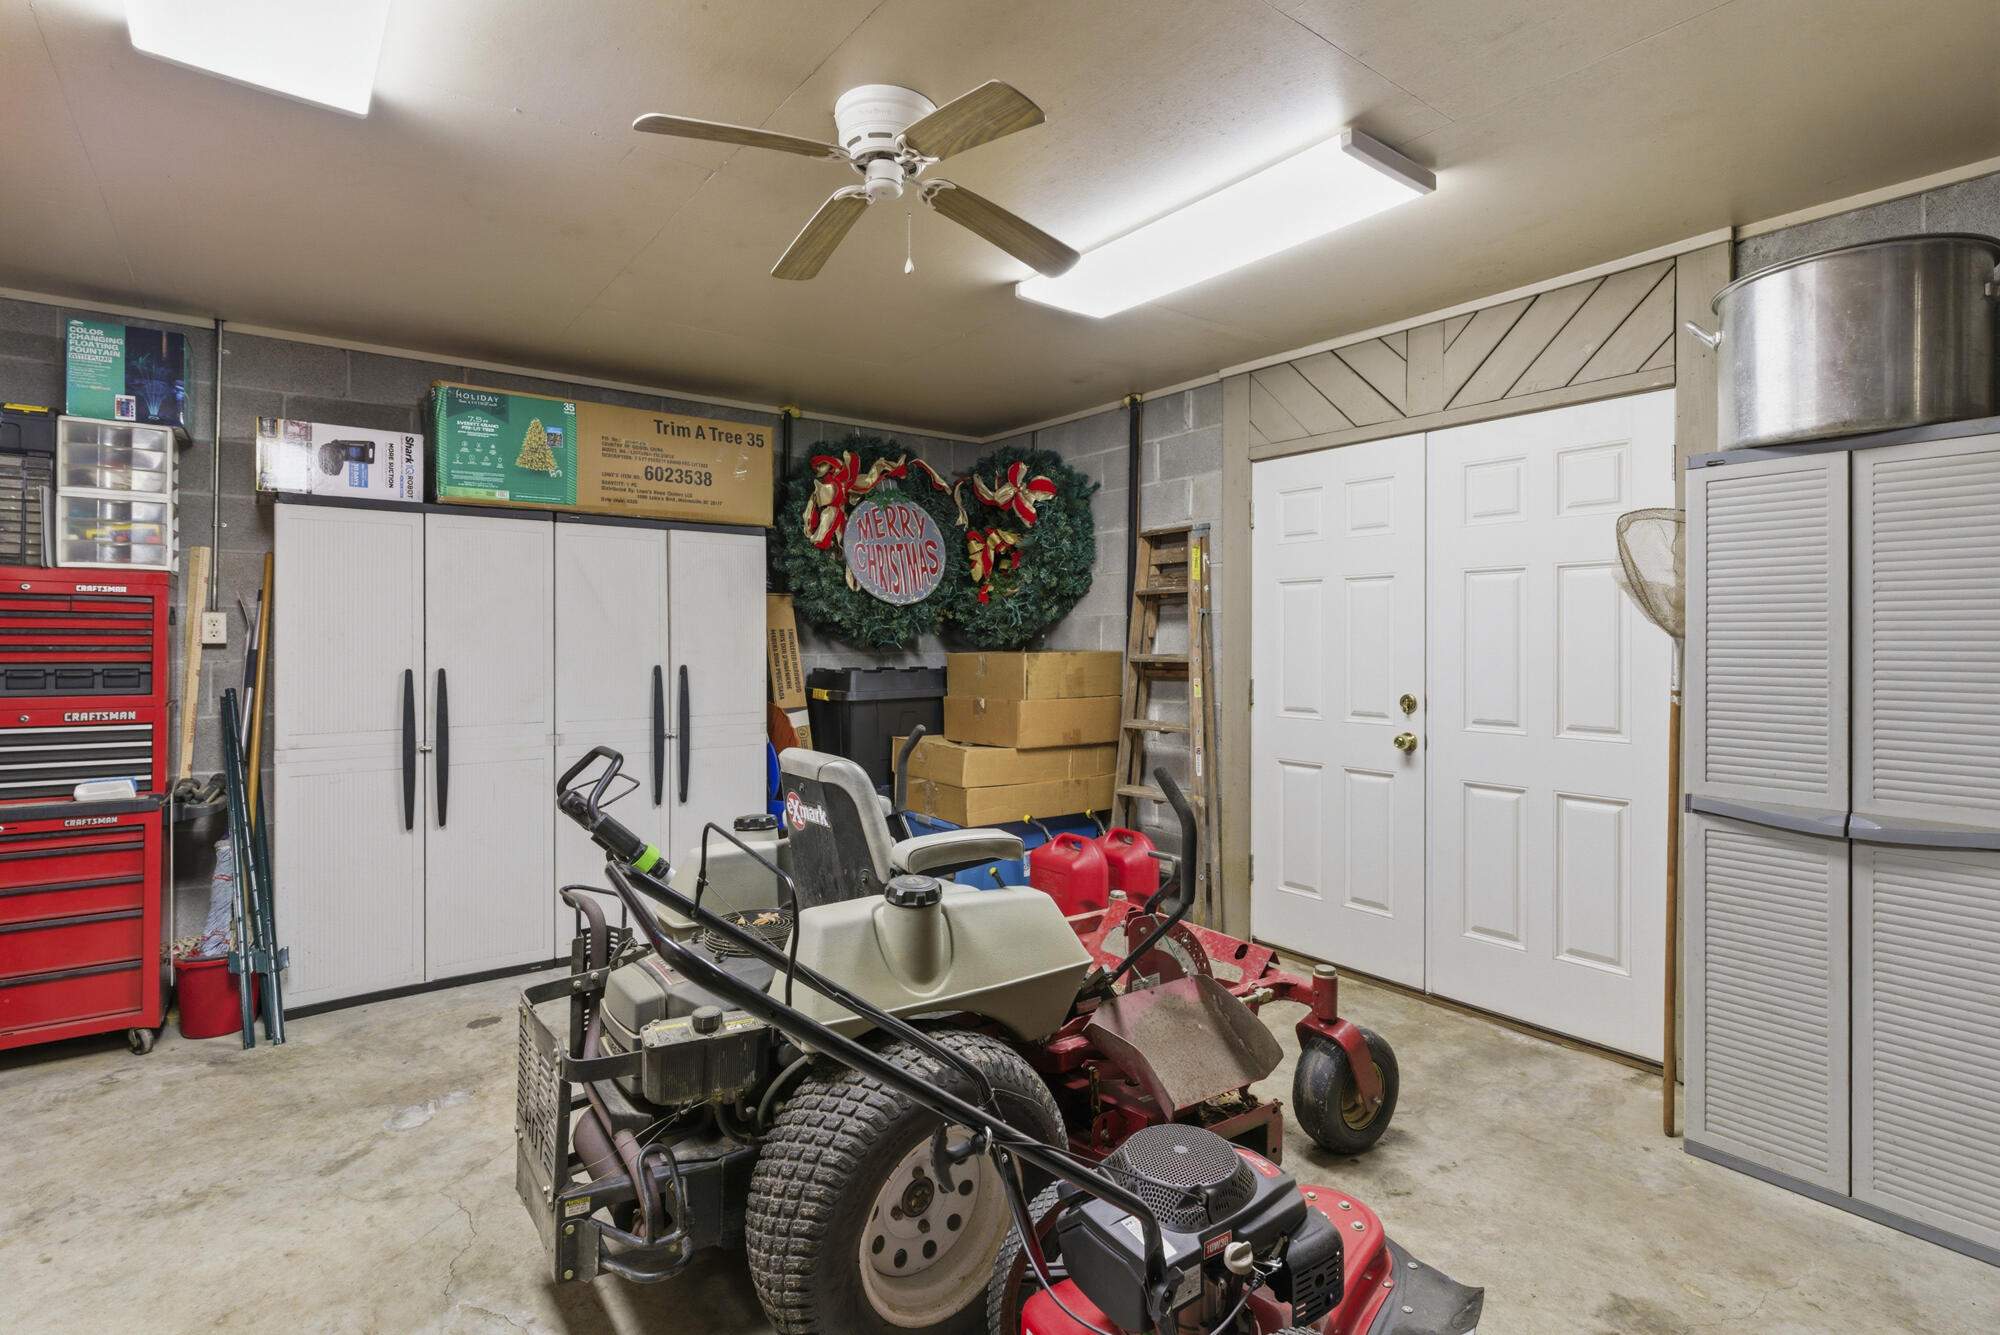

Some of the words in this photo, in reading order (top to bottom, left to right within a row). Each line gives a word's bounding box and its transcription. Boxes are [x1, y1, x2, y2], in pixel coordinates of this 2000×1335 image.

[69, 326, 104, 336] COLOR
[69, 333, 124, 345] CHANGING
[69, 339, 119, 351] FLOATING
[69, 346, 121, 358] FOUNTAIN
[455, 389, 500, 403] HOLIDAY
[563, 402, 575, 412] 35
[653, 419, 691, 438] Trim
[695, 424, 706, 440] A
[708, 426, 743, 445] Tree
[746, 432, 765, 448] 35
[405, 436, 415, 464] Shark
[644, 465, 713, 486] 6023538
[406, 476, 415, 499] ROBOT
[856, 505, 926, 541] MERRY
[854, 539, 940, 596] CHRISTMAS
[75, 584, 127, 593] CRAFTSMAN
[63, 711, 137, 722] CRAFTSMAN
[787, 798, 829, 827] eXmark
[64, 816, 119, 827] CRAFTSMAN
